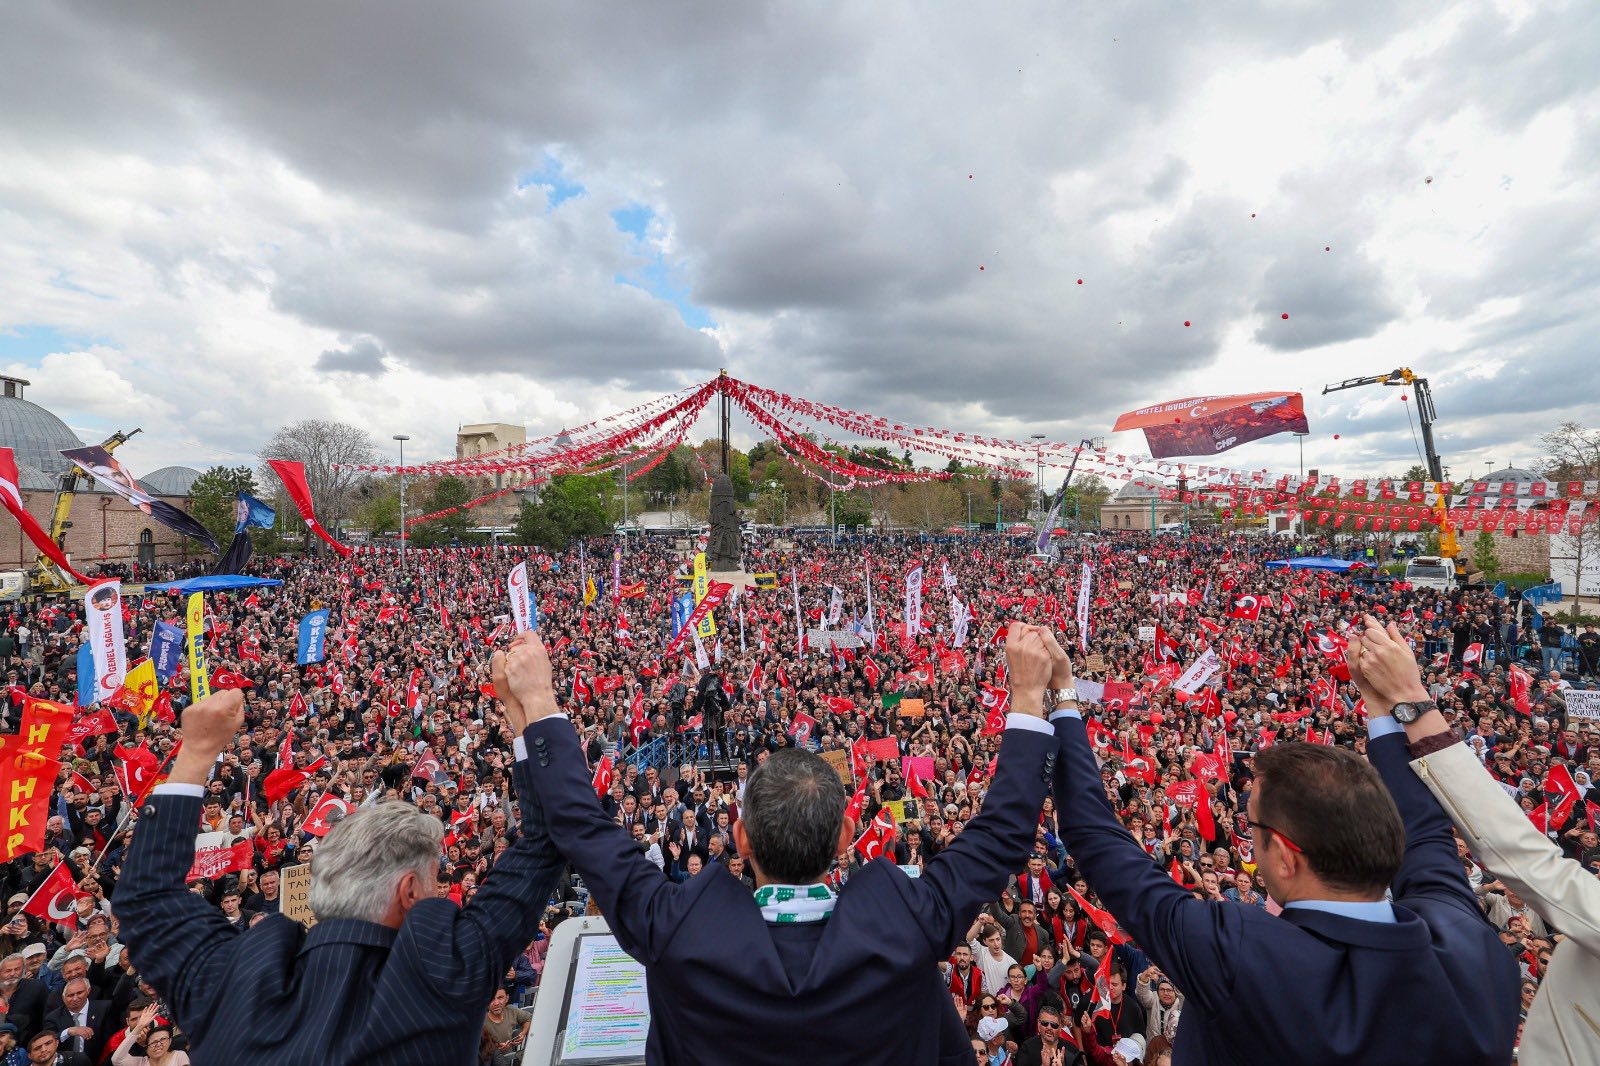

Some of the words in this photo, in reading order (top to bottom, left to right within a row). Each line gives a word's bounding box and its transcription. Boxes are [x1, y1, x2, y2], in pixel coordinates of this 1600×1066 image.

[1216, 436, 1237, 450] CHP
[106, 647, 117, 673] GENEL
[204, 860, 232, 878] CHP
